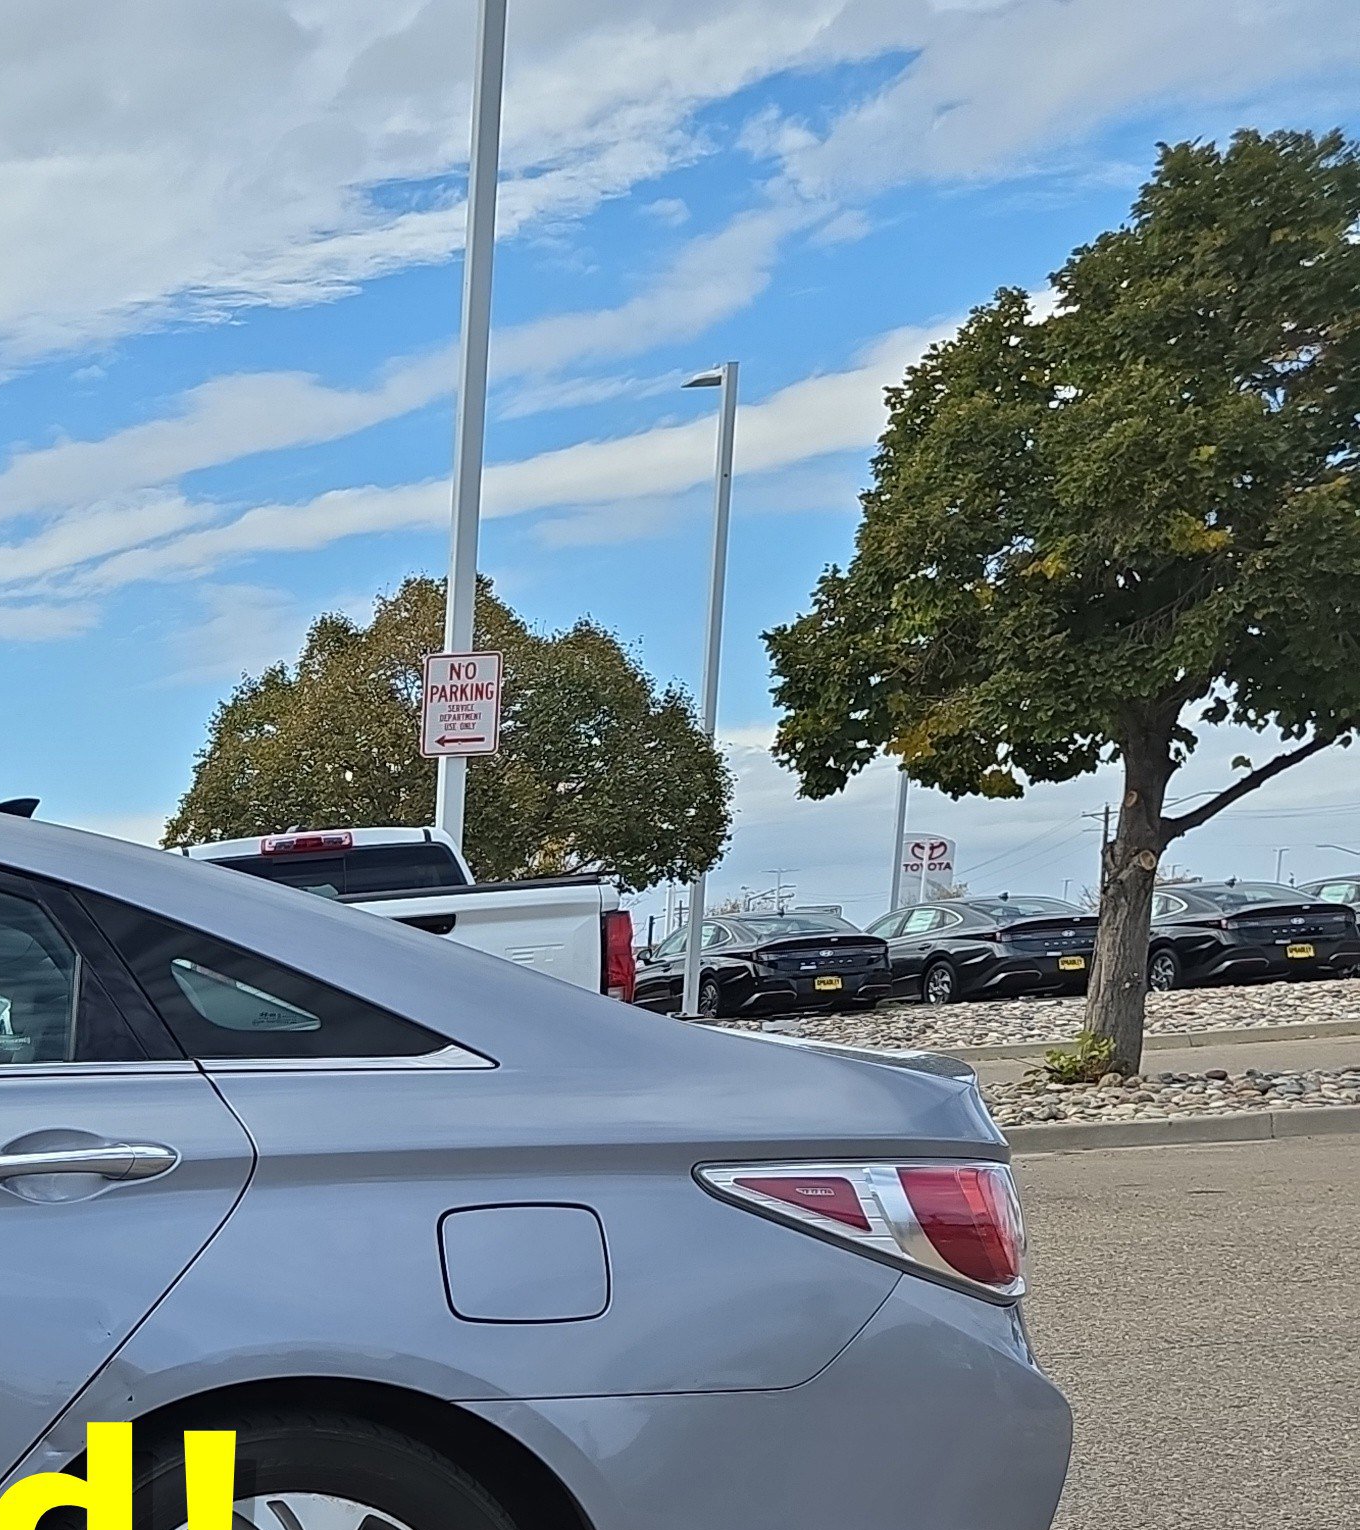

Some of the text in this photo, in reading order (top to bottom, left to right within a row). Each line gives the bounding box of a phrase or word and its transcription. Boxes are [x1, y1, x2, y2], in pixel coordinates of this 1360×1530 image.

[449, 662, 477, 680] NO
[430, 682, 494, 703] PARKING
[448, 704, 475, 712] SERVICE
[440, 713, 481, 722] DEPARTMENT
[444, 722, 476, 731] USE ONLY
[903, 862, 952, 872] TOOTA
